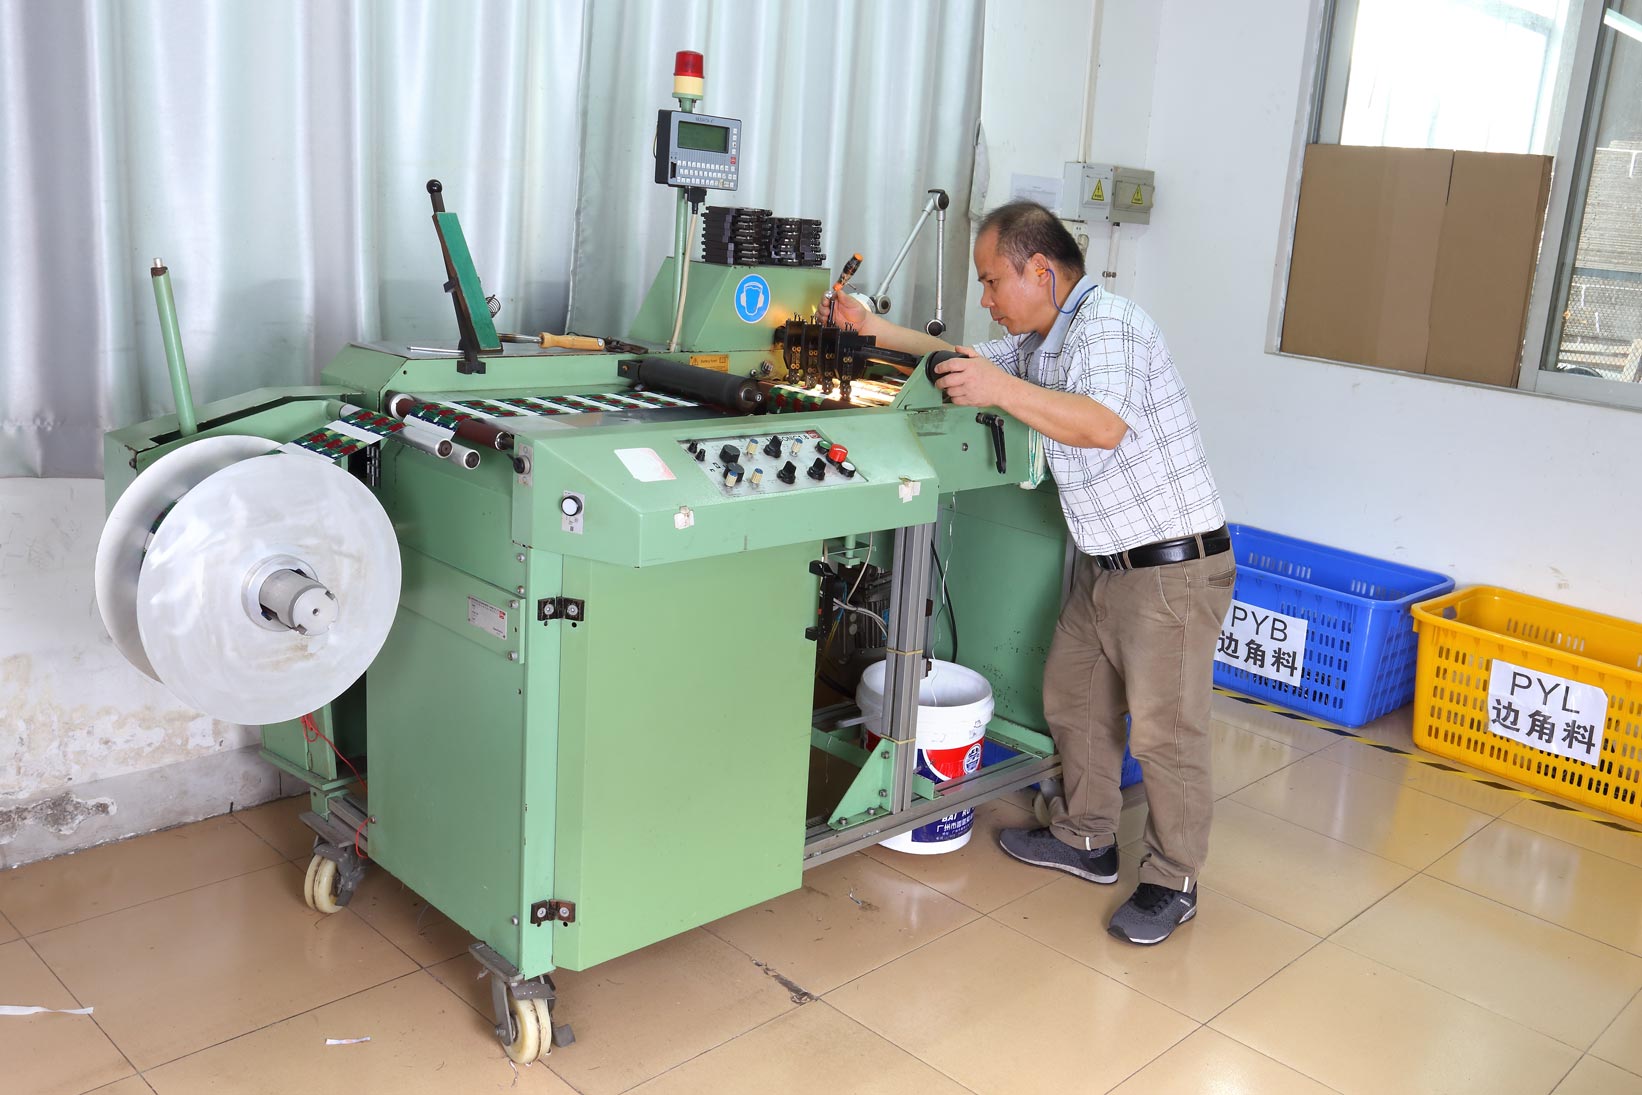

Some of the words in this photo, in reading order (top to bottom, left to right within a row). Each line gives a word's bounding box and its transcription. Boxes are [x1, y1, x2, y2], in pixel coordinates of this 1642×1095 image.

[1231, 605, 1288, 642] PYB
[1217, 630, 1298, 677] 边角料
[1510, 671, 1580, 714] PYL
[1491, 698, 1596, 755] 边角料
